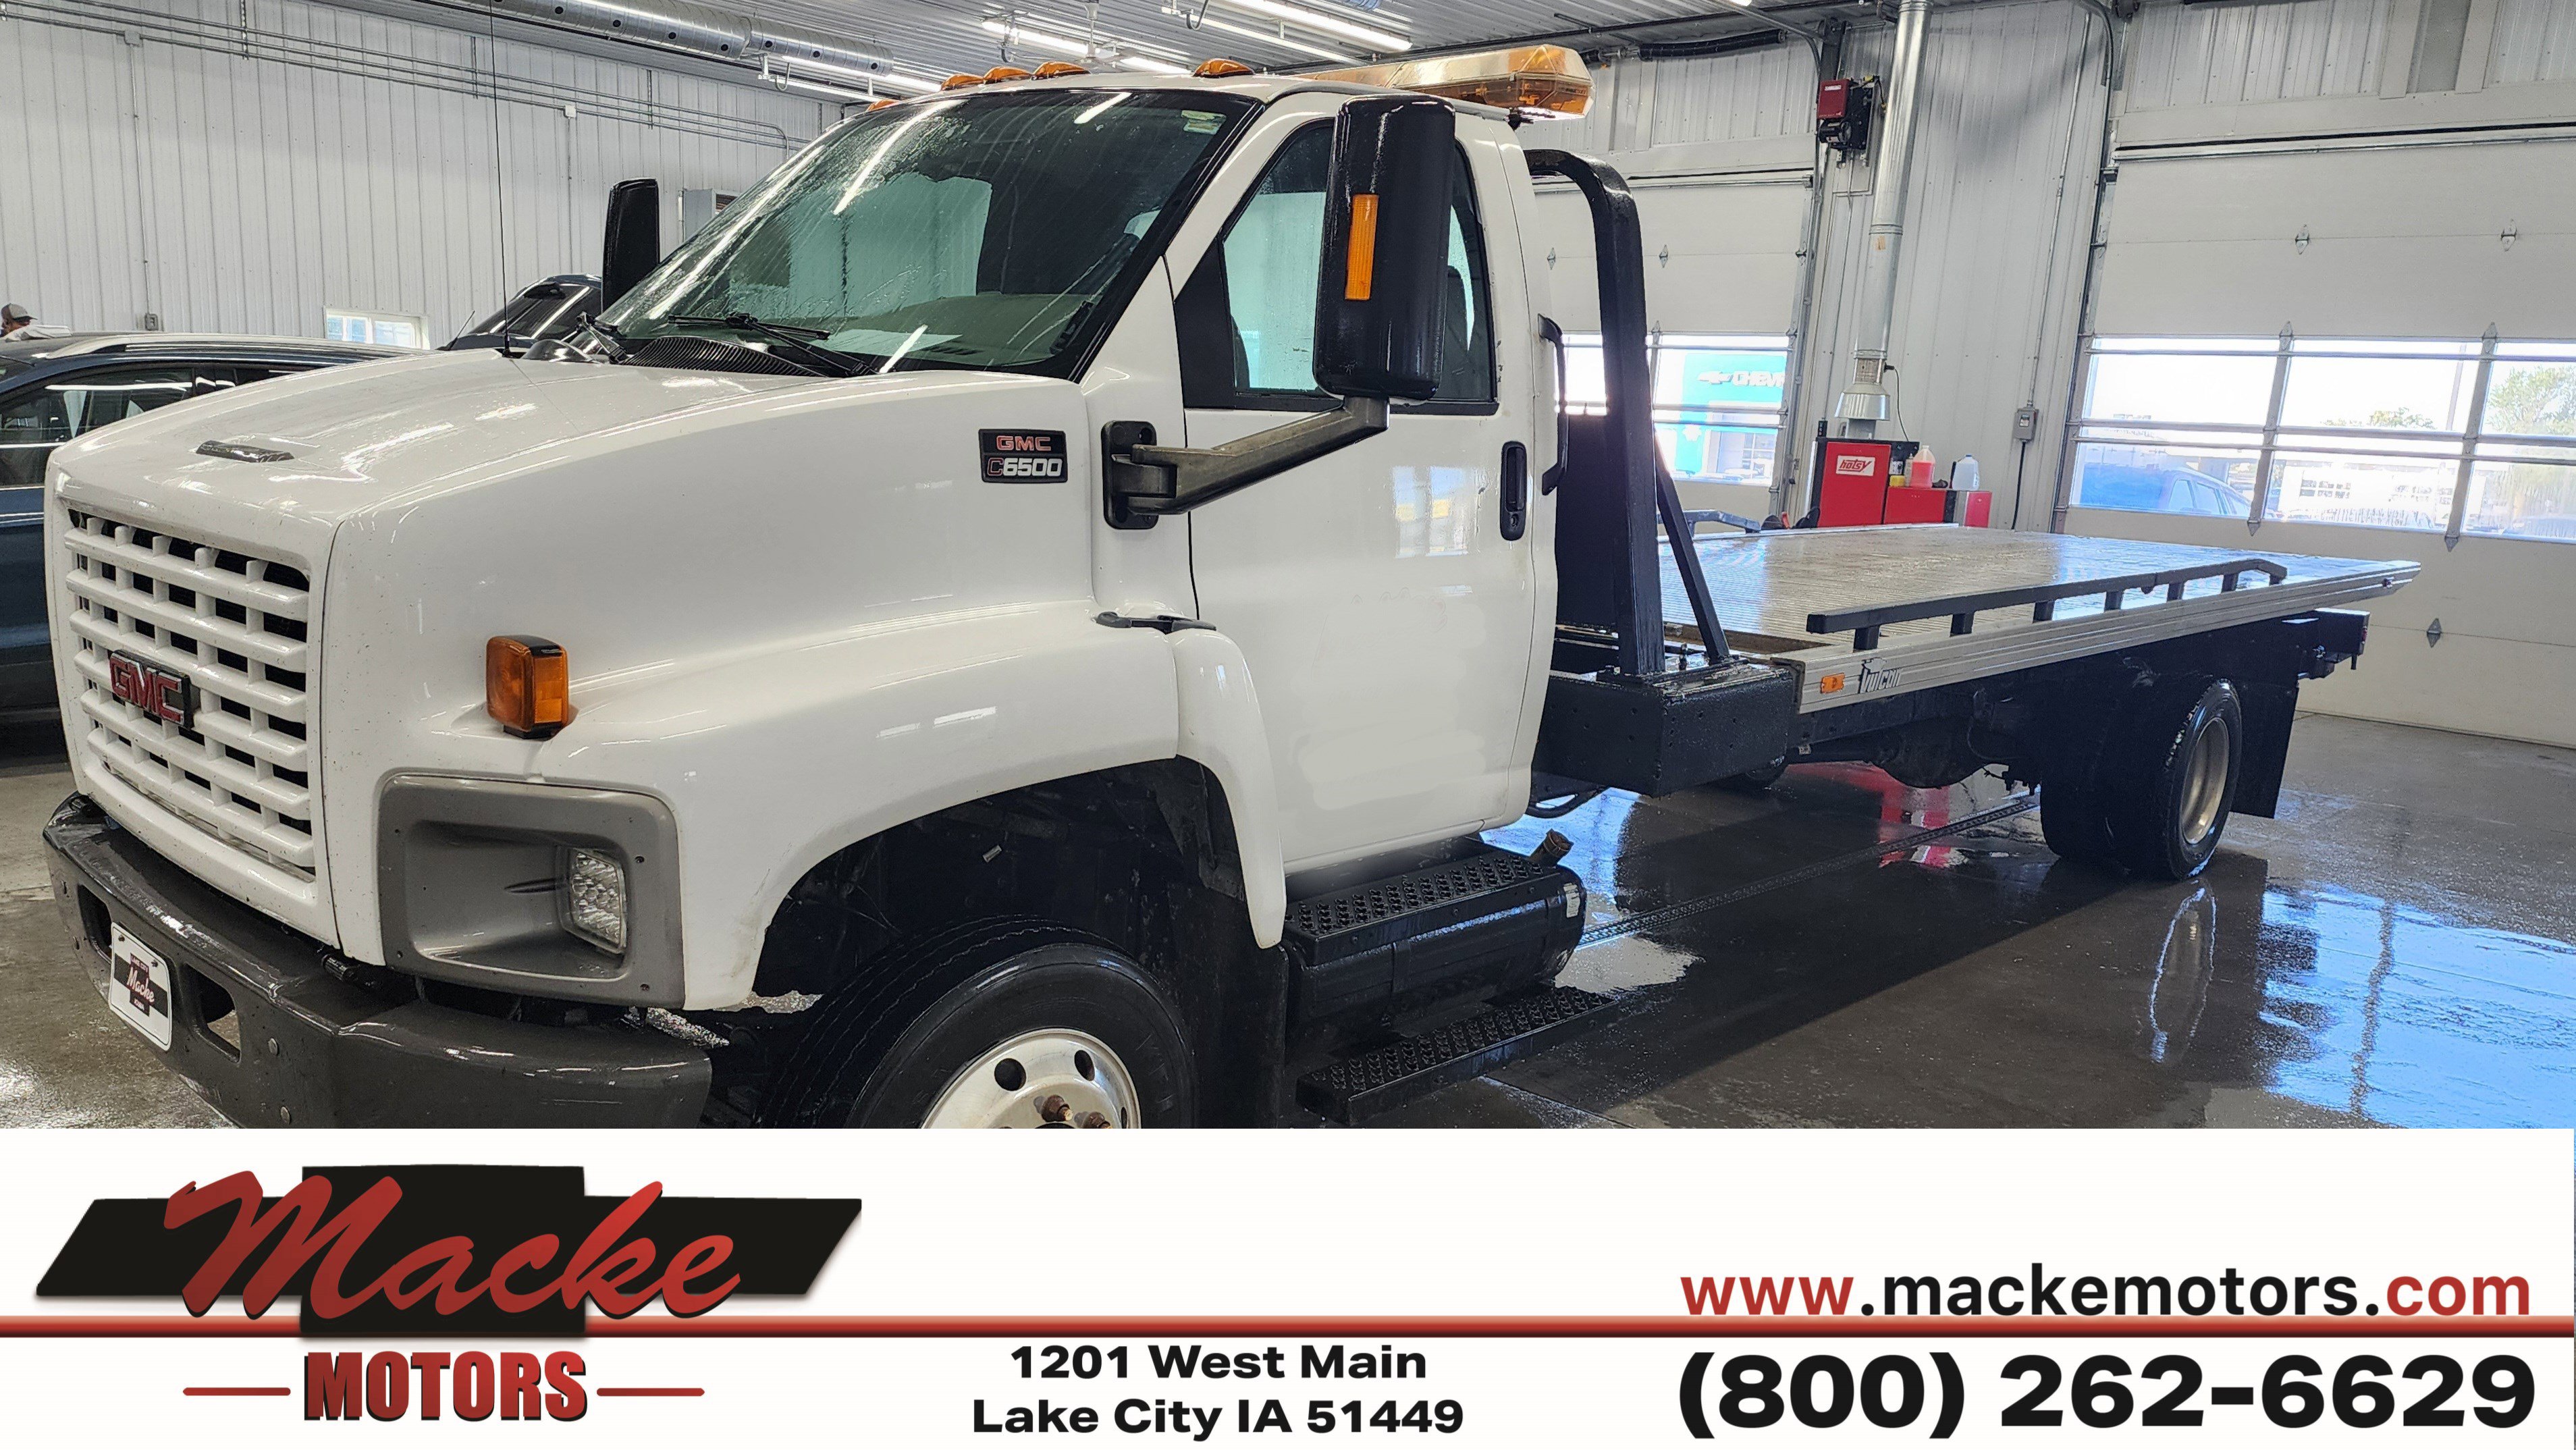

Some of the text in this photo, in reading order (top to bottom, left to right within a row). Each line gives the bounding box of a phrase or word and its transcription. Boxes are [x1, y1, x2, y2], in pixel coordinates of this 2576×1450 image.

[996, 435, 1052, 451] GMC
[987, 457, 1063, 477] C6500
[109, 652, 185, 727] GMC
[126, 967, 155, 1003] Macke
